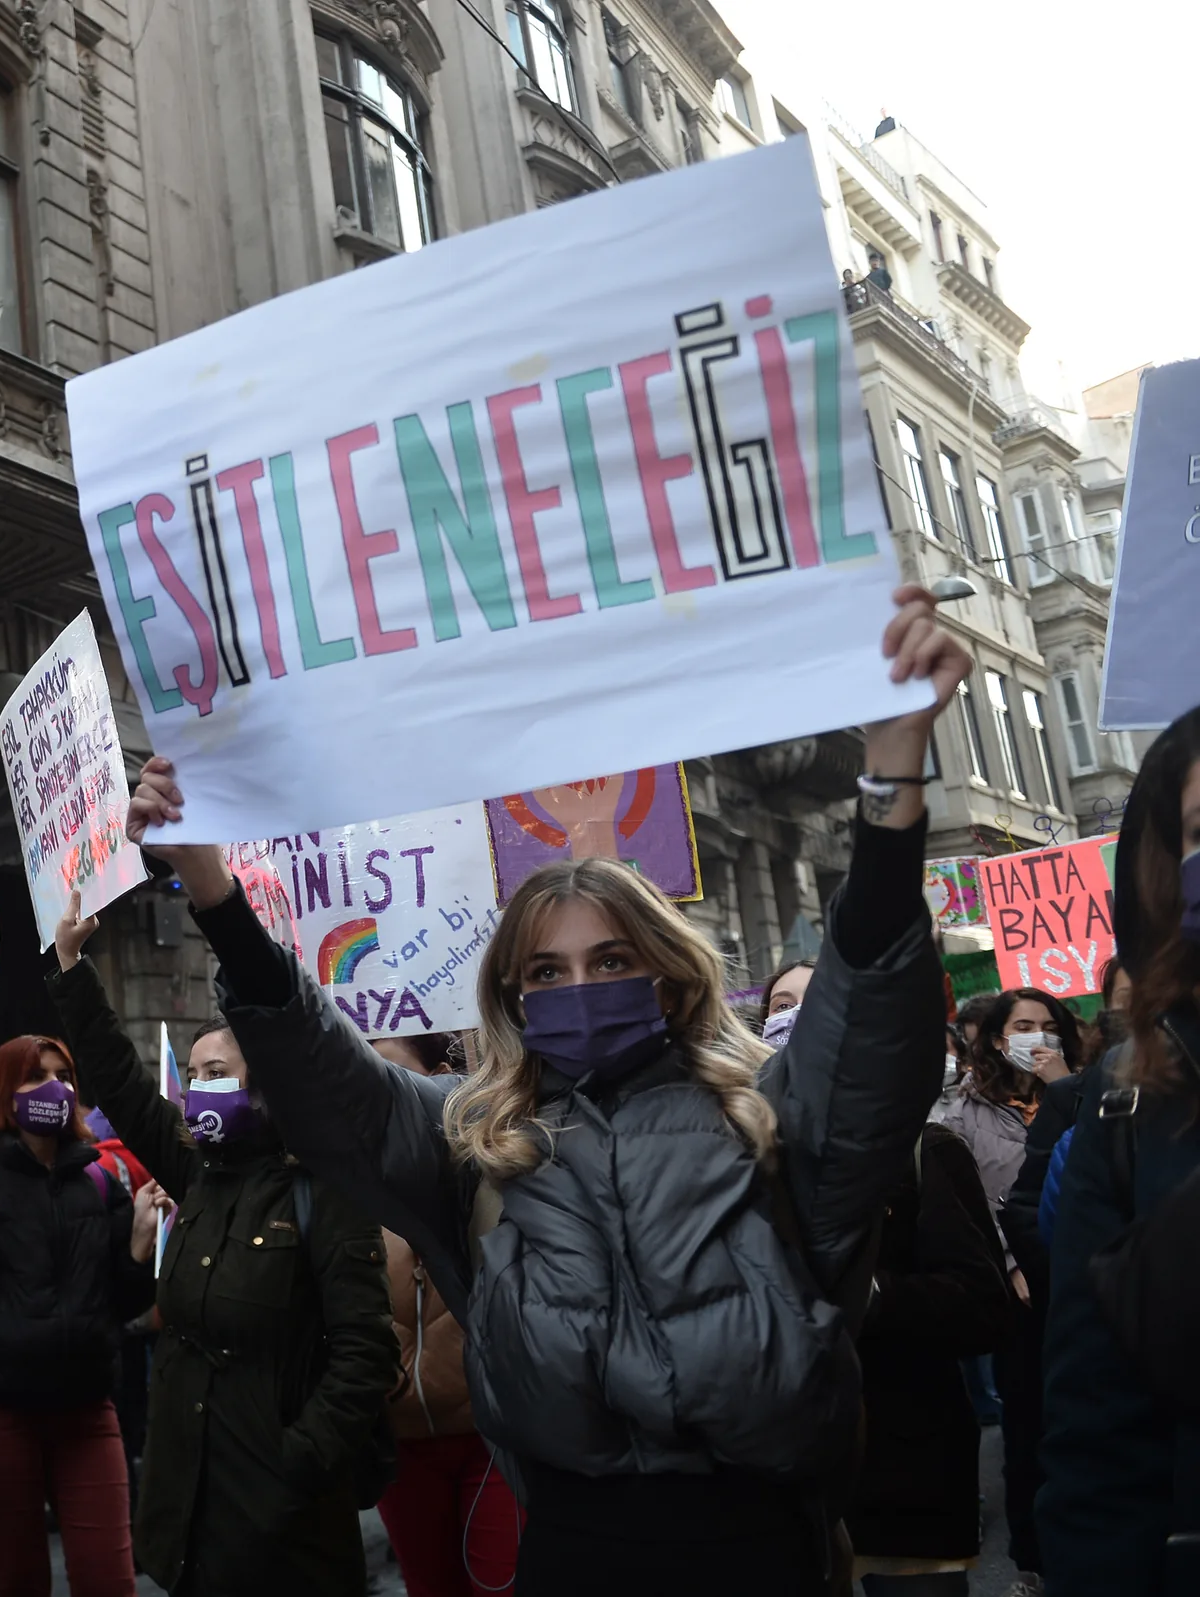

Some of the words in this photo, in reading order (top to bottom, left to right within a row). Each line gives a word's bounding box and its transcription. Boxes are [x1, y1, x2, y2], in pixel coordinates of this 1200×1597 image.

[29, 725, 52, 773] GÜN
[984, 850, 1086, 907] HATTA
[382, 928, 429, 968] var
[334, 985, 434, 1034] NYA
